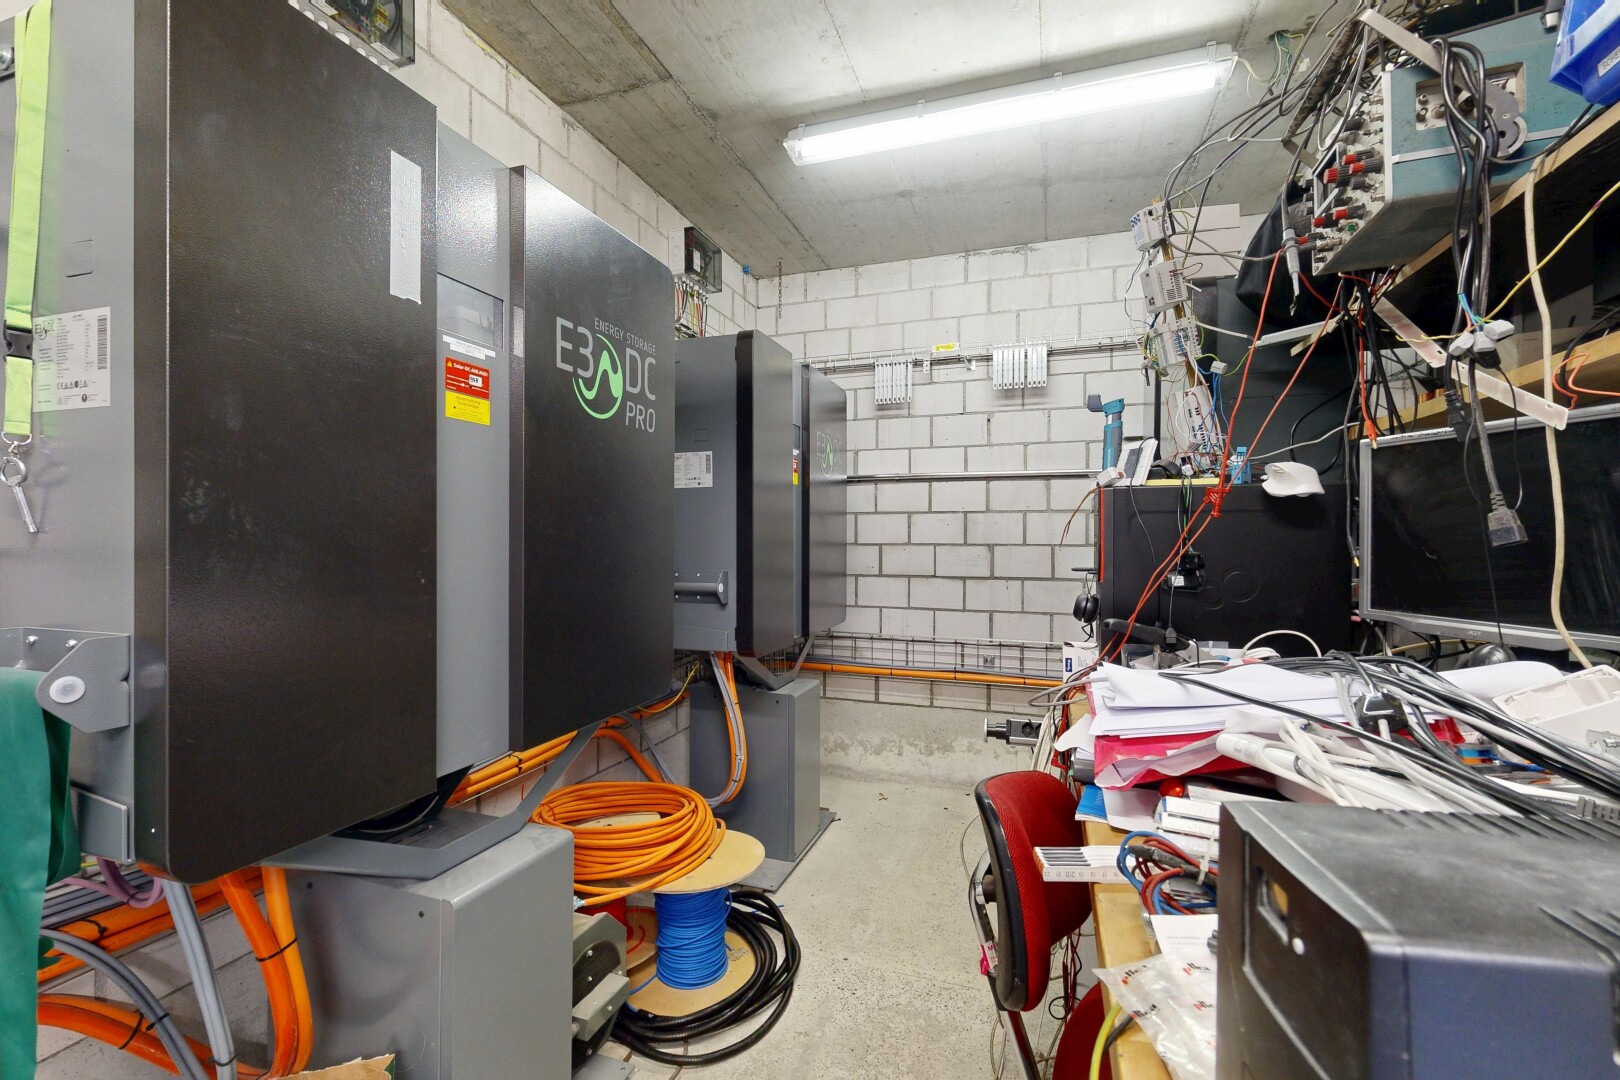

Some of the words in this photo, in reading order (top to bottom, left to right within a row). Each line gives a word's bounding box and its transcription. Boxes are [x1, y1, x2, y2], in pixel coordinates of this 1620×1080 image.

[594, 317, 624, 341] ENERGY
[626, 332, 656, 356] STORAGE
[556, 316, 594, 378] E3
[625, 346, 656, 401] DC
[625, 400, 656, 433] PRO
